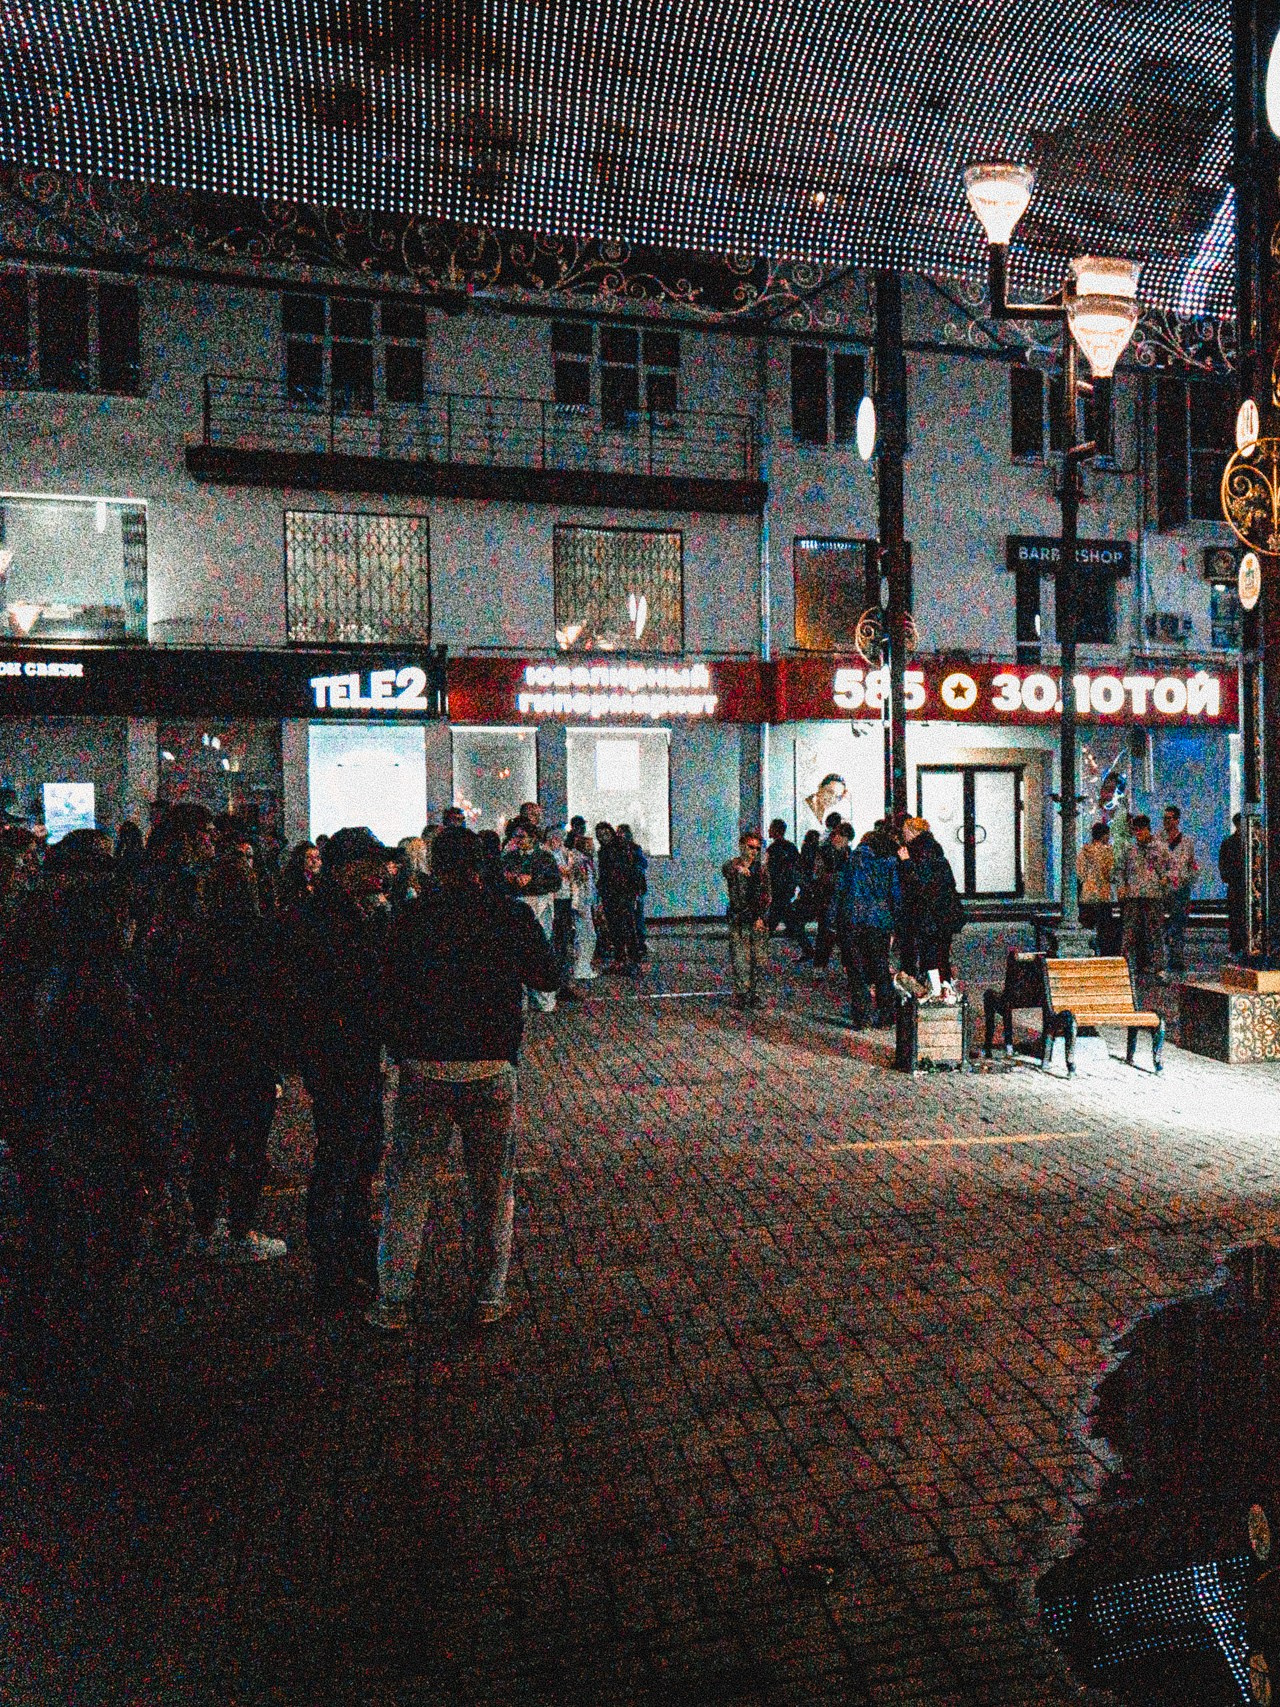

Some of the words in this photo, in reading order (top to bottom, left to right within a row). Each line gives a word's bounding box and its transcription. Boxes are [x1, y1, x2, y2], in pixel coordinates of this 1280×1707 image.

[1019, 547, 1124, 565] BARBSHOP
[311, 667, 428, 710] TELE2
[832, 667, 926, 710] 585
